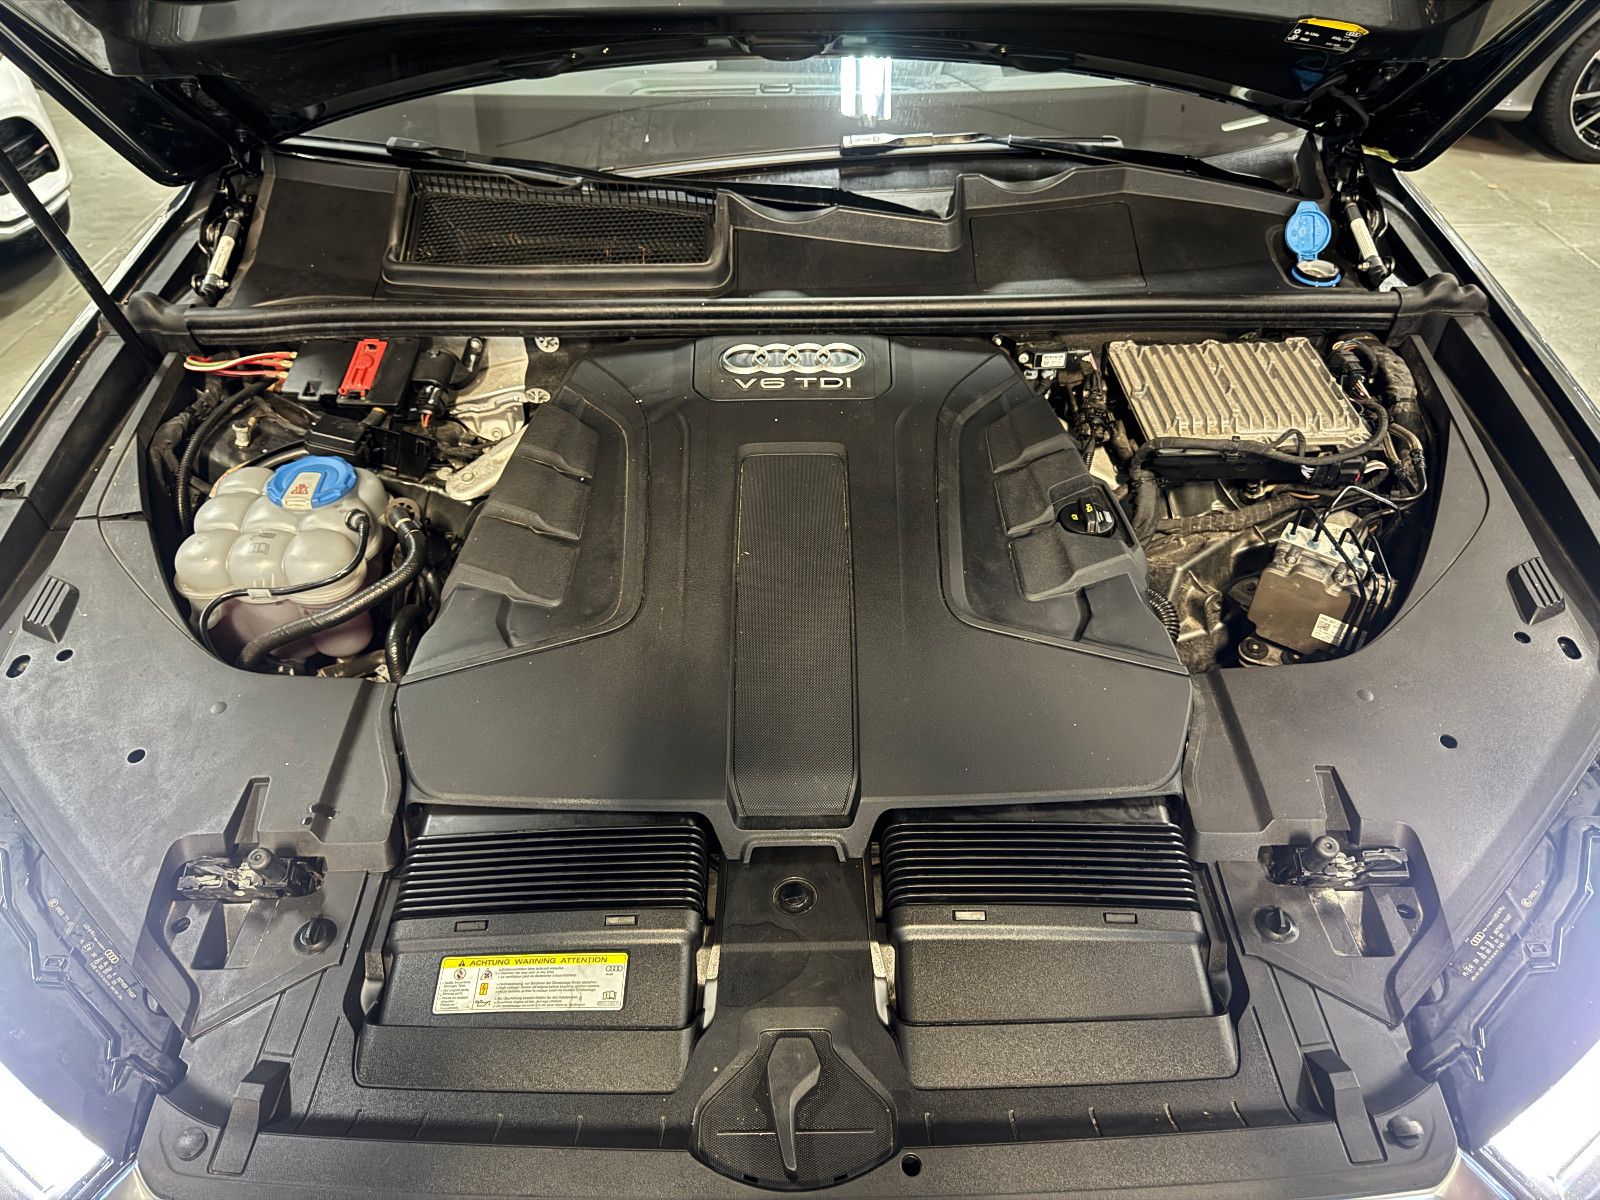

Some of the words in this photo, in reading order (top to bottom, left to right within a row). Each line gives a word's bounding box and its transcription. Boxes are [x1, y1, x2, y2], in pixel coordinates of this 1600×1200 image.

[734, 377, 785, 389] V6
[794, 377, 852, 389] TDI
[469, 958, 510, 966] ACHTUNG
[514, 957, 556, 965] WARNING
[560, 956, 608, 964] ATTENTION
